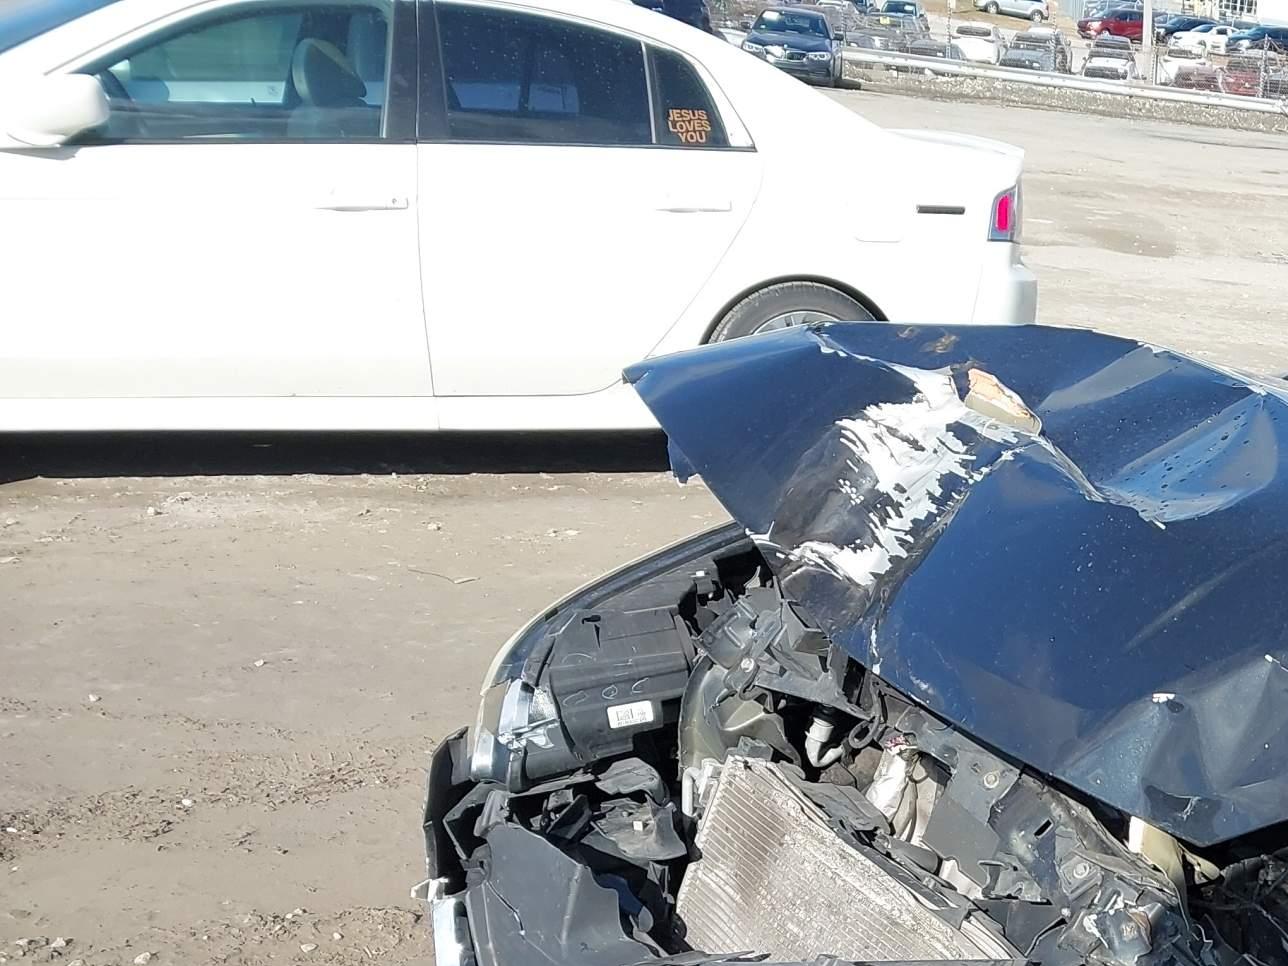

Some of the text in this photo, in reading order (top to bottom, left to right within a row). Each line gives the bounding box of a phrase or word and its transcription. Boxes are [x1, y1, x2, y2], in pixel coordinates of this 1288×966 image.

[667, 109, 708, 121] JESUS
[667, 120, 711, 132] LOVES
[677, 131, 706, 143] YOU
